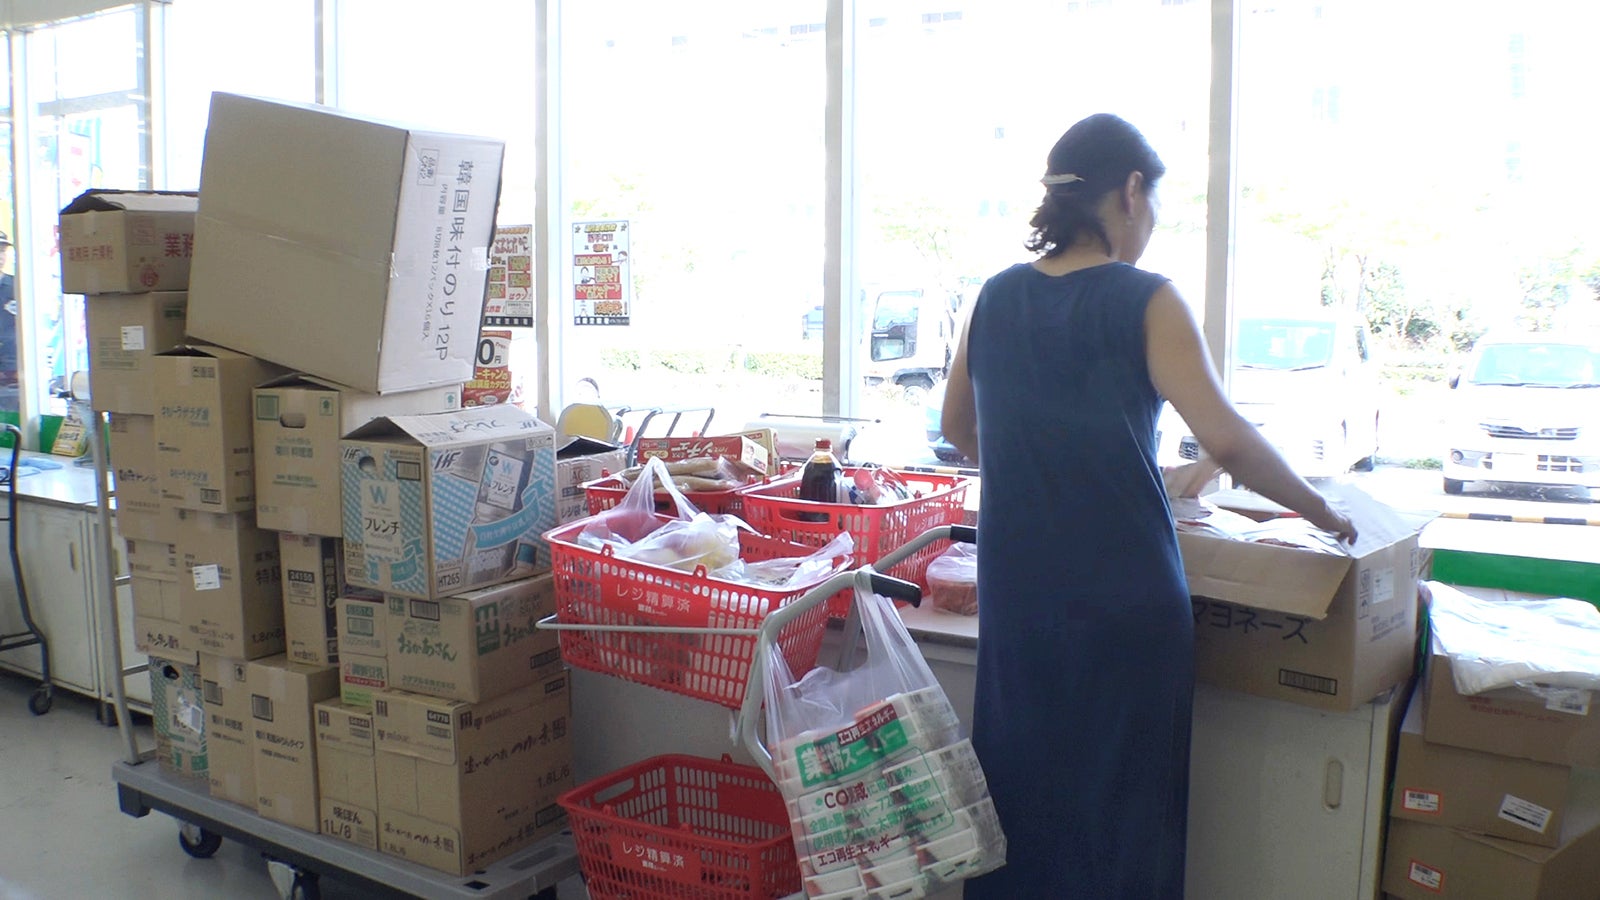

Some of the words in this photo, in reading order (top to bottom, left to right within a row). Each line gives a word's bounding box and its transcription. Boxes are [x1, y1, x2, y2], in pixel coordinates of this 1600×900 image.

[440, 160, 474, 315] 韓国味付のり
[435, 326, 451, 361] 12P
[475, 368, 508, 380] ーキャンの
[370, 485, 388, 505] W
[491, 482, 516, 495] フレンチ
[364, 517, 400, 535] フレンチ
[438, 572, 461, 588] HT265
[616, 583, 691, 613] レジ精算済
[1193, 601, 1312, 645] マヨネーズ
[397, 631, 458, 662] おかあさん
[801, 728, 900, 781] 業務スーパー
[323, 818, 352, 840] 1L/8
[622, 840, 685, 869] レジ精算済
